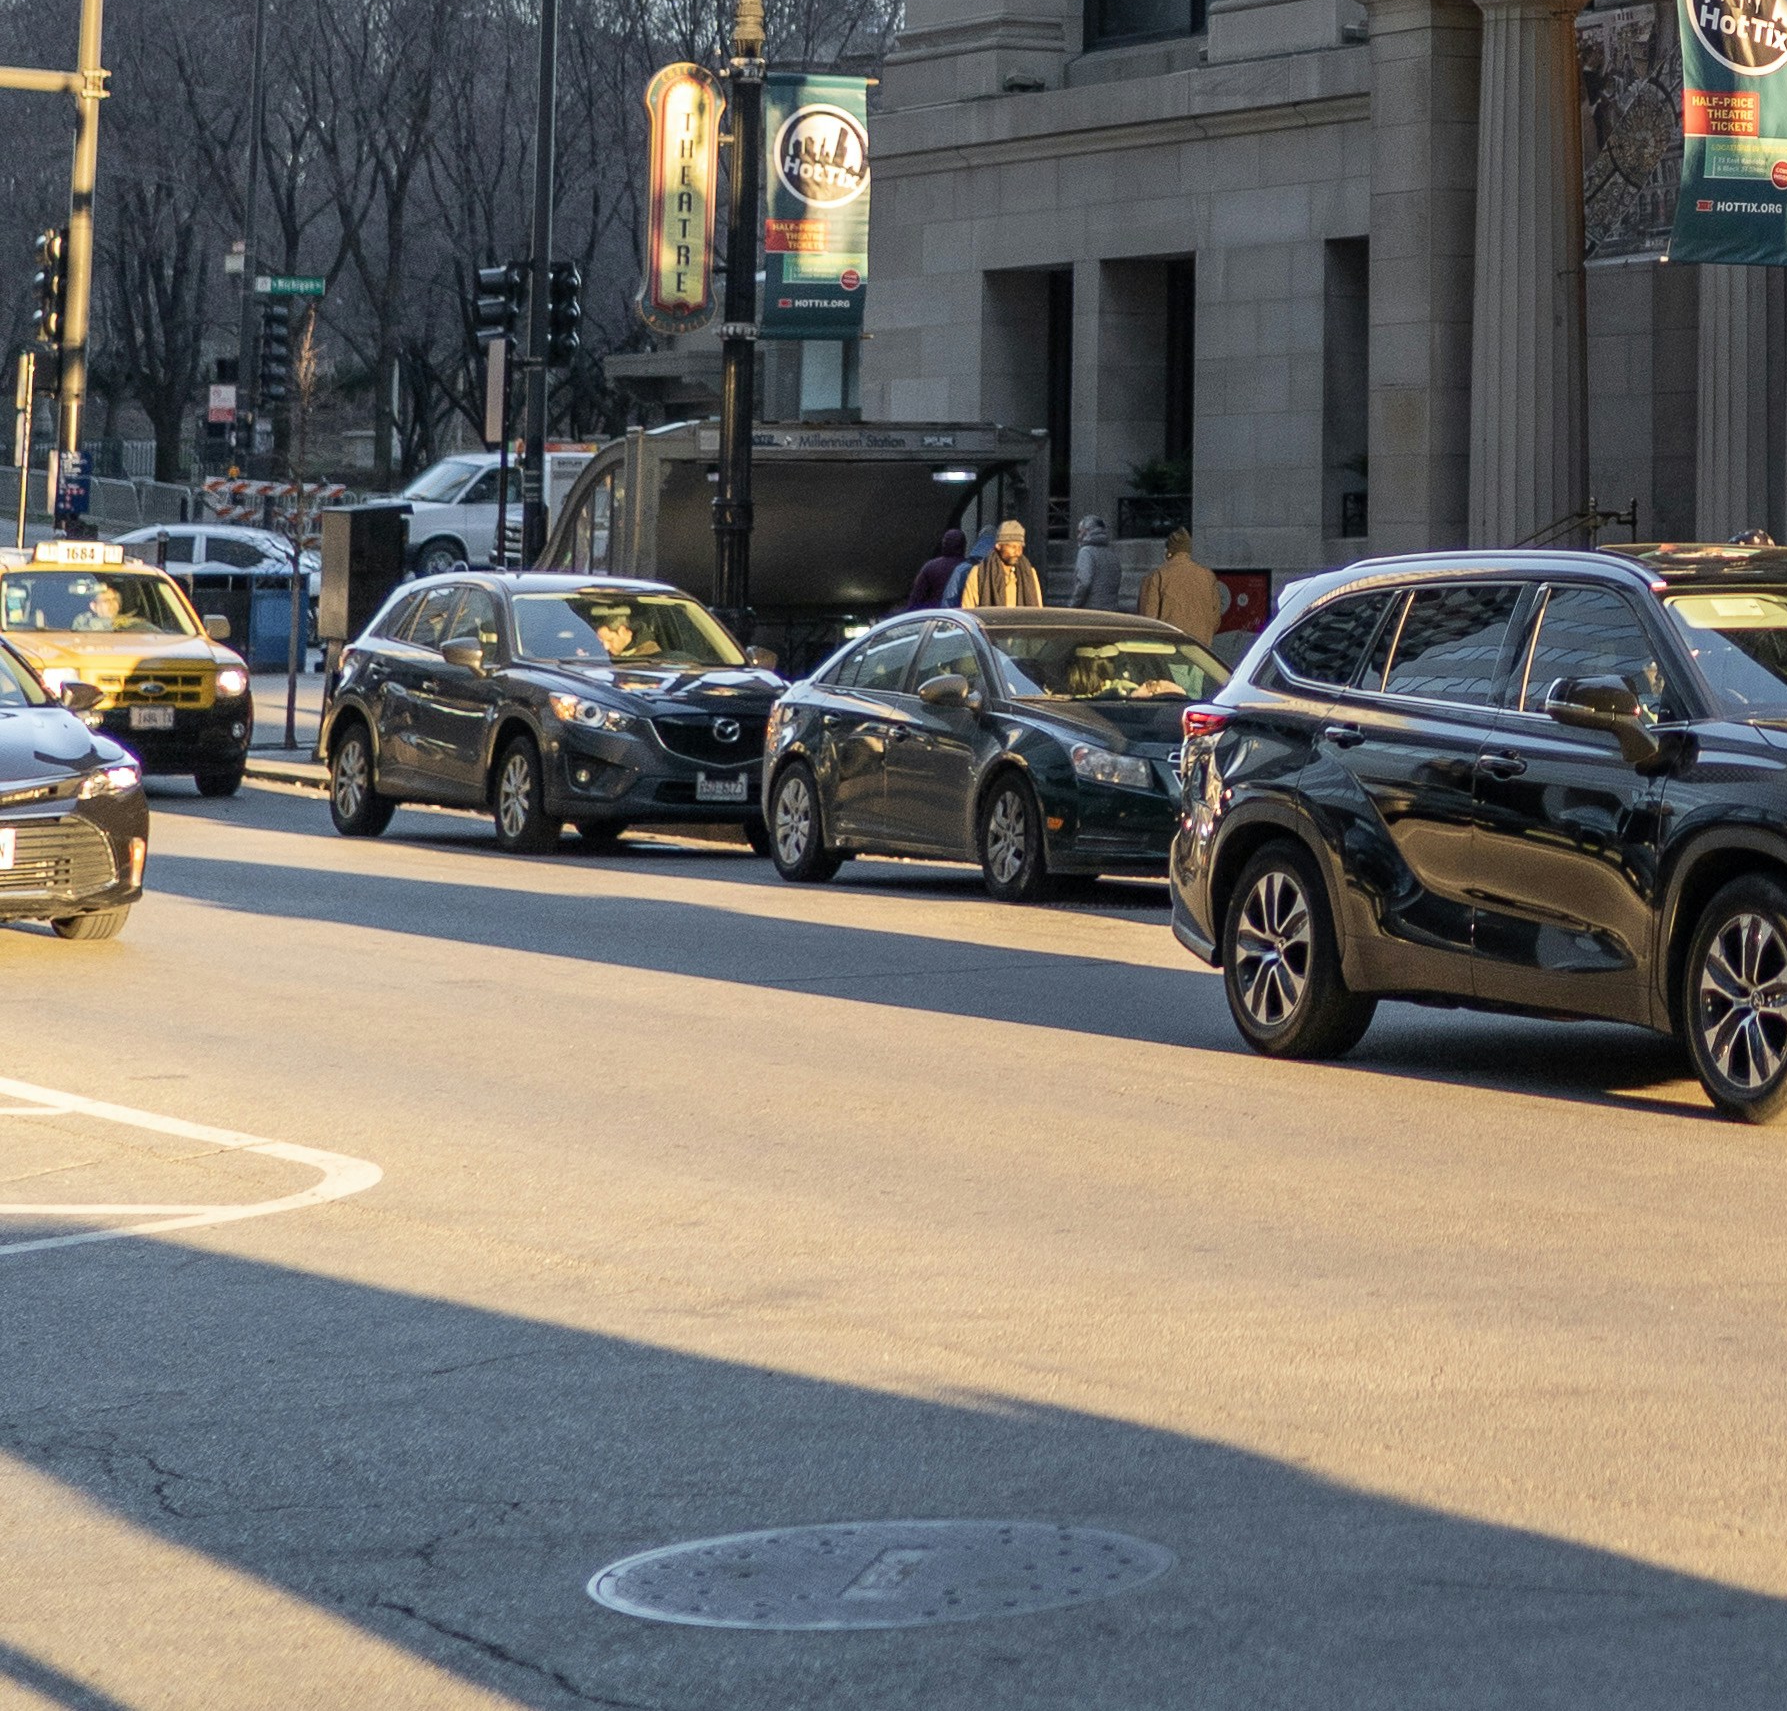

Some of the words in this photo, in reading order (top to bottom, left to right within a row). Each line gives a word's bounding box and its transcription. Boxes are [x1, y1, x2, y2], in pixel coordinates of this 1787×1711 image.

[1691, 95, 1755, 109] HALF-PRICE
[1707, 109, 1754, 121] THEATRE
[1710, 121, 1754, 132] TICKETS
[675, 112, 695, 295] THEATRE
[1716, 201, 1783, 214] HOTTIX.ORG
[794, 299, 851, 308] HOTTIX.ORG
[799, 433, 863, 448] Millennium
[865, 434, 906, 448] Station
[66, 547, 96, 561] 1684
